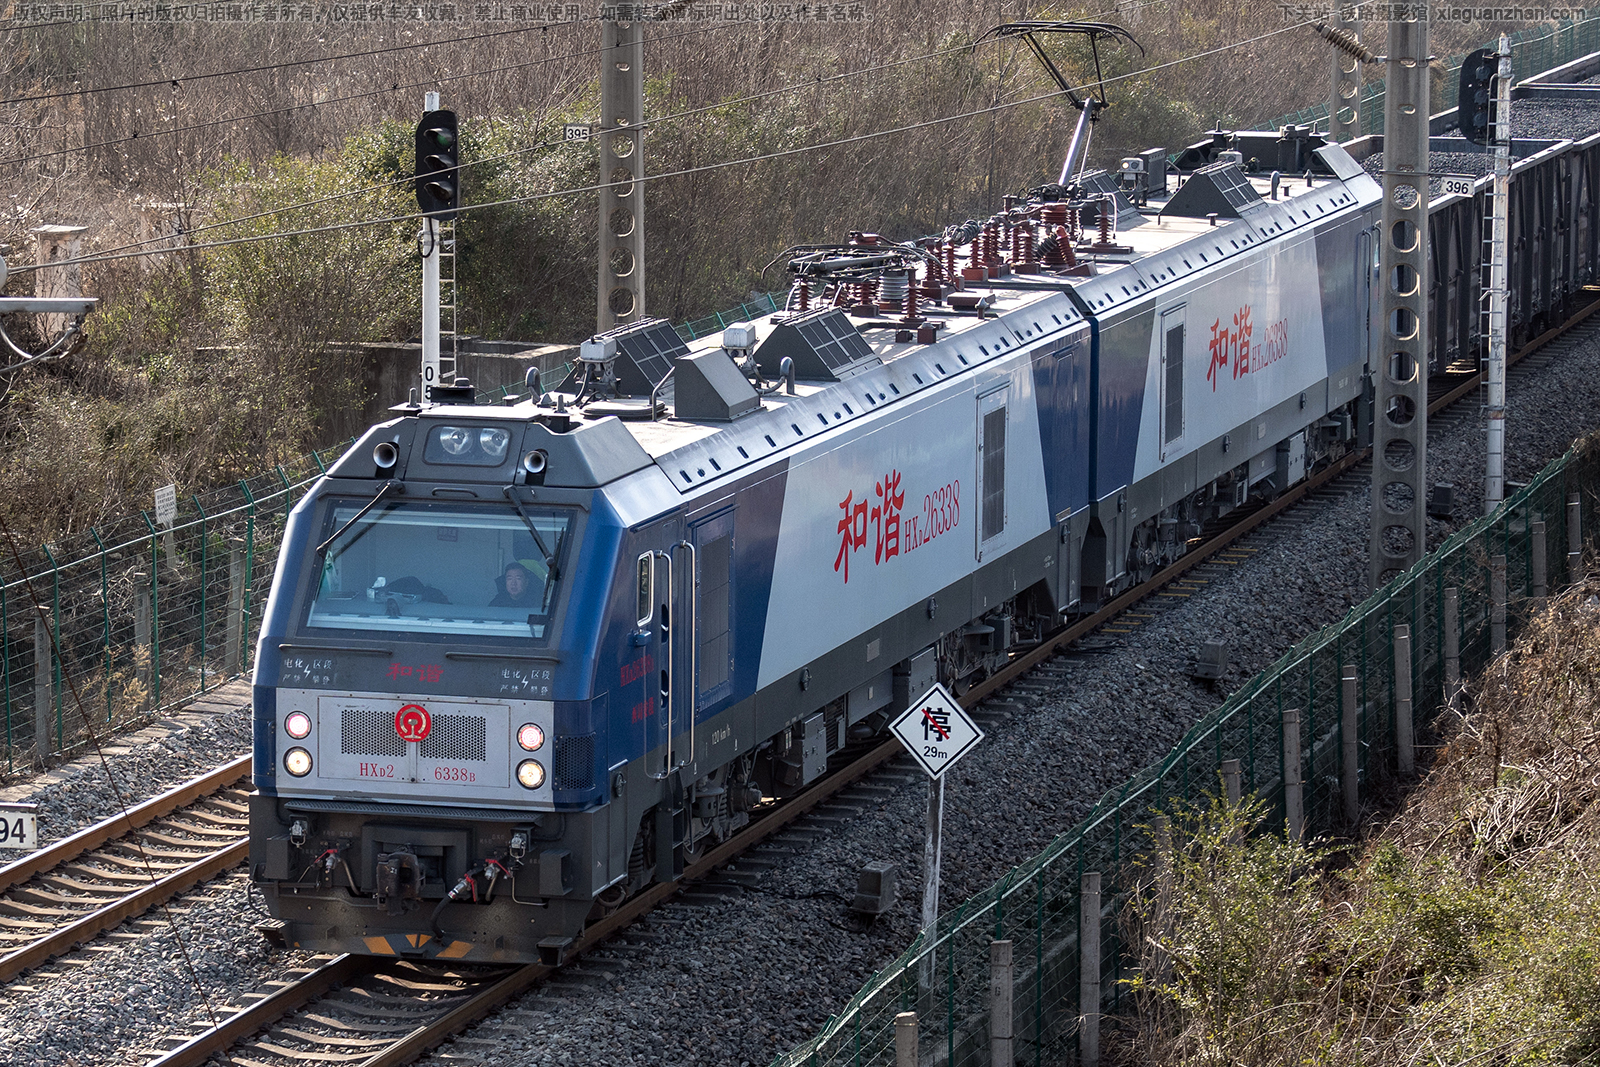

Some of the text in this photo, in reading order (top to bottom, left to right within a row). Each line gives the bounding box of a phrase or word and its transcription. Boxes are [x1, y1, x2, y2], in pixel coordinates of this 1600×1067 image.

[567, 128, 588, 140] 395
[1445, 180, 1469, 194] 396
[1206, 304, 1253, 393] 和谐
[834, 468, 905, 584] 和谐
[385, 662, 445, 683] 和谐
[920, 706, 952, 742] 停
[923, 745, 948, 759] 29m
[359, 762, 476, 783] HXD2 6338B
